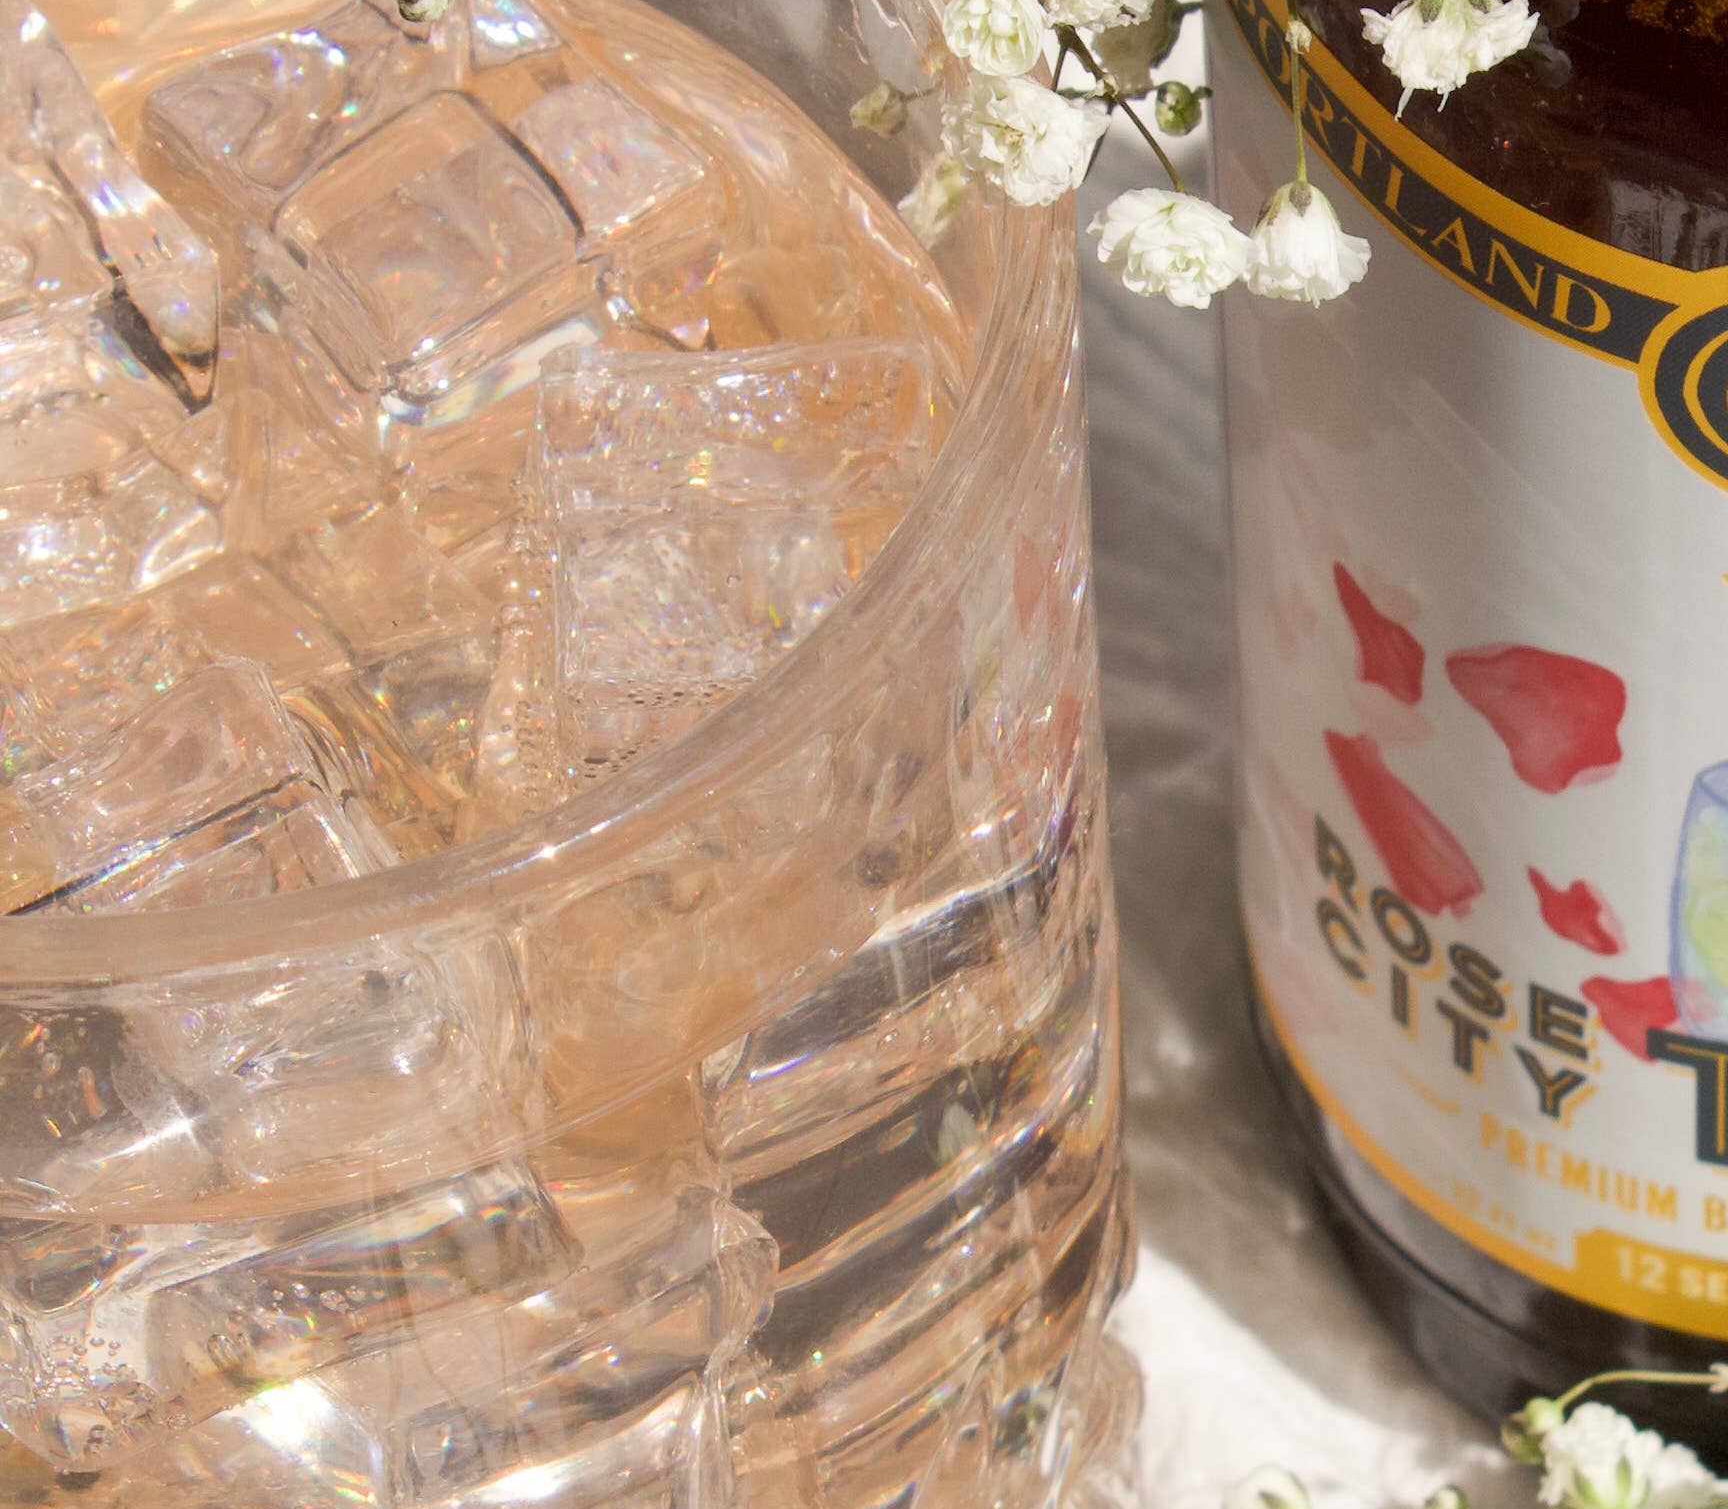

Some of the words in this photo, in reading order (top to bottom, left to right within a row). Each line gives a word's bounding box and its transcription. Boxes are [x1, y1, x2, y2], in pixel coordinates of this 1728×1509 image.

[1314, 811, 1602, 1073] ROSE
[1315, 896, 1597, 1128] CITY
[1479, 1111, 1679, 1223] PREMIUM
[1615, 1246, 1668, 1294] 12
